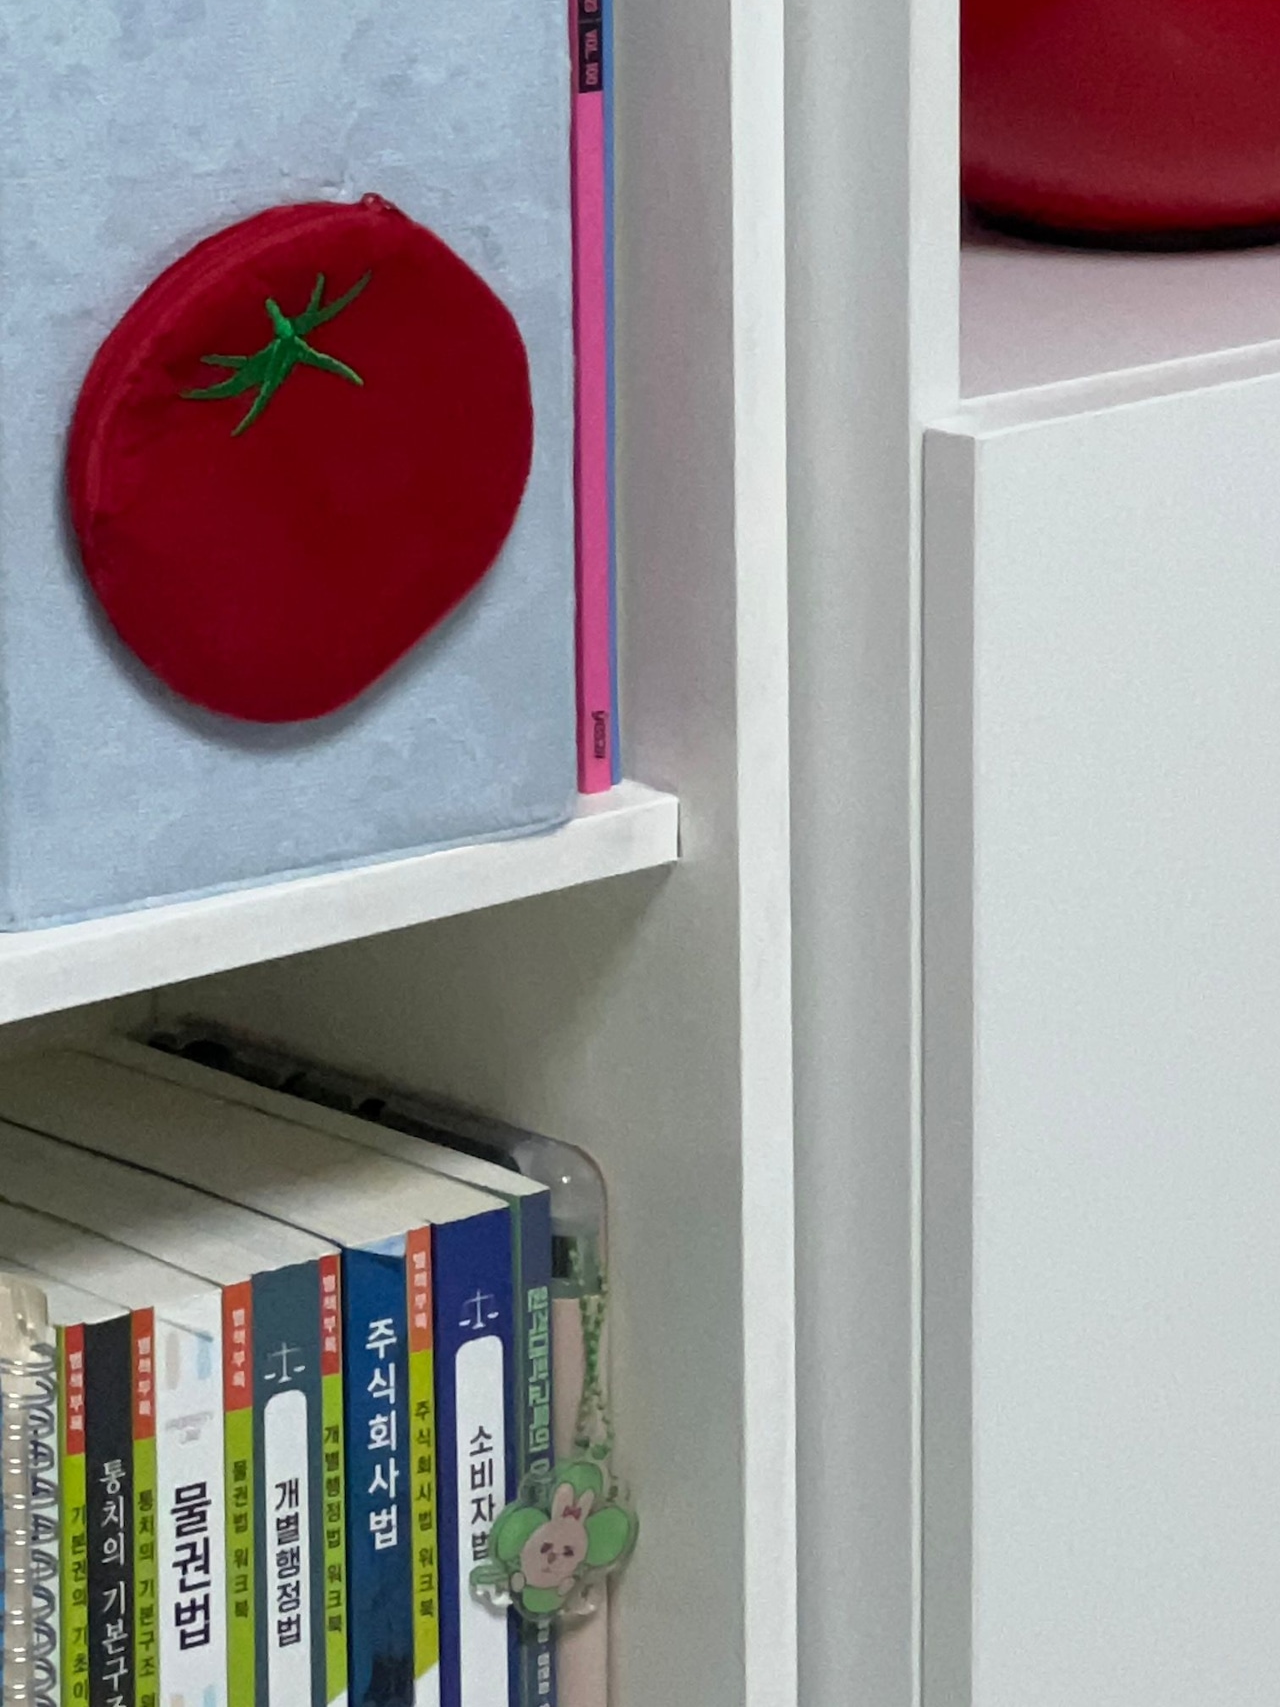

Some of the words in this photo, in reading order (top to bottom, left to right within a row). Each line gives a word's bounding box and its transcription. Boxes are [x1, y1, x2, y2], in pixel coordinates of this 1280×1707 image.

[365, 1317, 400, 1551] 주식회사법
[415, 1399, 434, 1533] 주식회사법
[99, 1459, 128, 1568] 통치의
[137, 1488, 156, 1563] 통치의
[231, 1459, 250, 1535] 물권법
[323, 1424, 343, 1551] 개별행정법
[70, 1505, 88, 1608] 기본권의
[169, 1480, 214, 1652] 물권법
[233, 1546, 250, 1620] 워크북
[274, 1477, 303, 1650] 개별행정법
[326, 1562, 344, 1635] 워크북
[418, 1545, 436, 1619] 워크북
[138, 1579, 157, 1677] 기본구조
